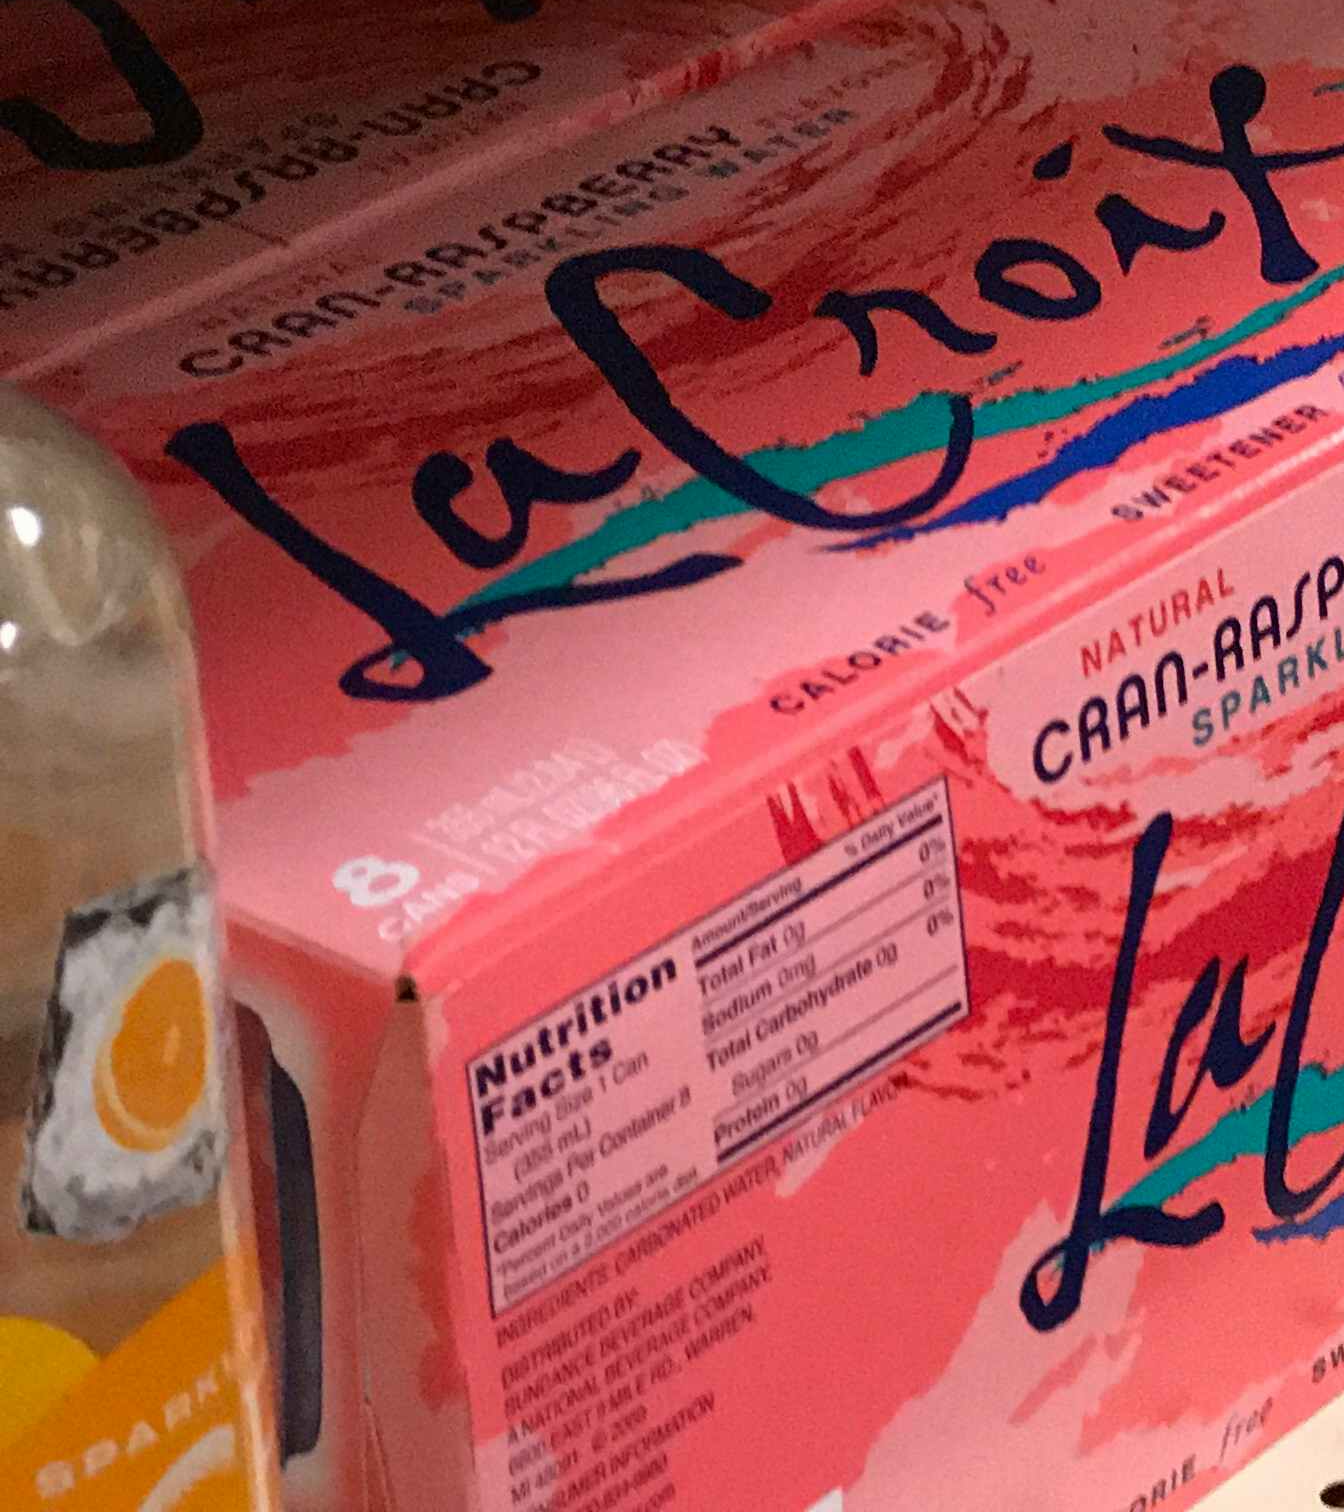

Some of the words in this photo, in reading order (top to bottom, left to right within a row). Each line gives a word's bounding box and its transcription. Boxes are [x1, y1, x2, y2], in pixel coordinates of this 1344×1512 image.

[178, 122, 743, 380] CRAN-RASPBERRY
[768, 609, 951, 720] CALORIE
[961, 551, 1047, 619] free
[1109, 402, 1328, 526] SWEETENER
[1080, 566, 1236, 678] NATURAL
[331, 854, 420, 909] 8
[691, 876, 803, 953] Amount/Serving
[699, 954, 745, 998] Total
[748, 935, 778, 967] Fat
[918, 837, 947, 864] 0%
[701, 980, 773, 1036] Sodium
[922, 872, 950, 900] 0%
[705, 1029, 751, 1073] Total
[754, 956, 874, 1043] Carbohydrate
[926, 907, 955, 938] 0%
[475, 956, 678, 1099] Nutrition
[730, 1045, 793, 1098] Sugars
[480, 1038, 614, 1137] Facts
[483, 1110, 552, 1166] Serving
[611, 1052, 649, 1086] Can
[713, 1090, 781, 1146] Protein
[490, 1168, 564, 1226] Servings
[598, 1095, 676, 1159] Container
[493, 1194, 573, 1255] Calories
